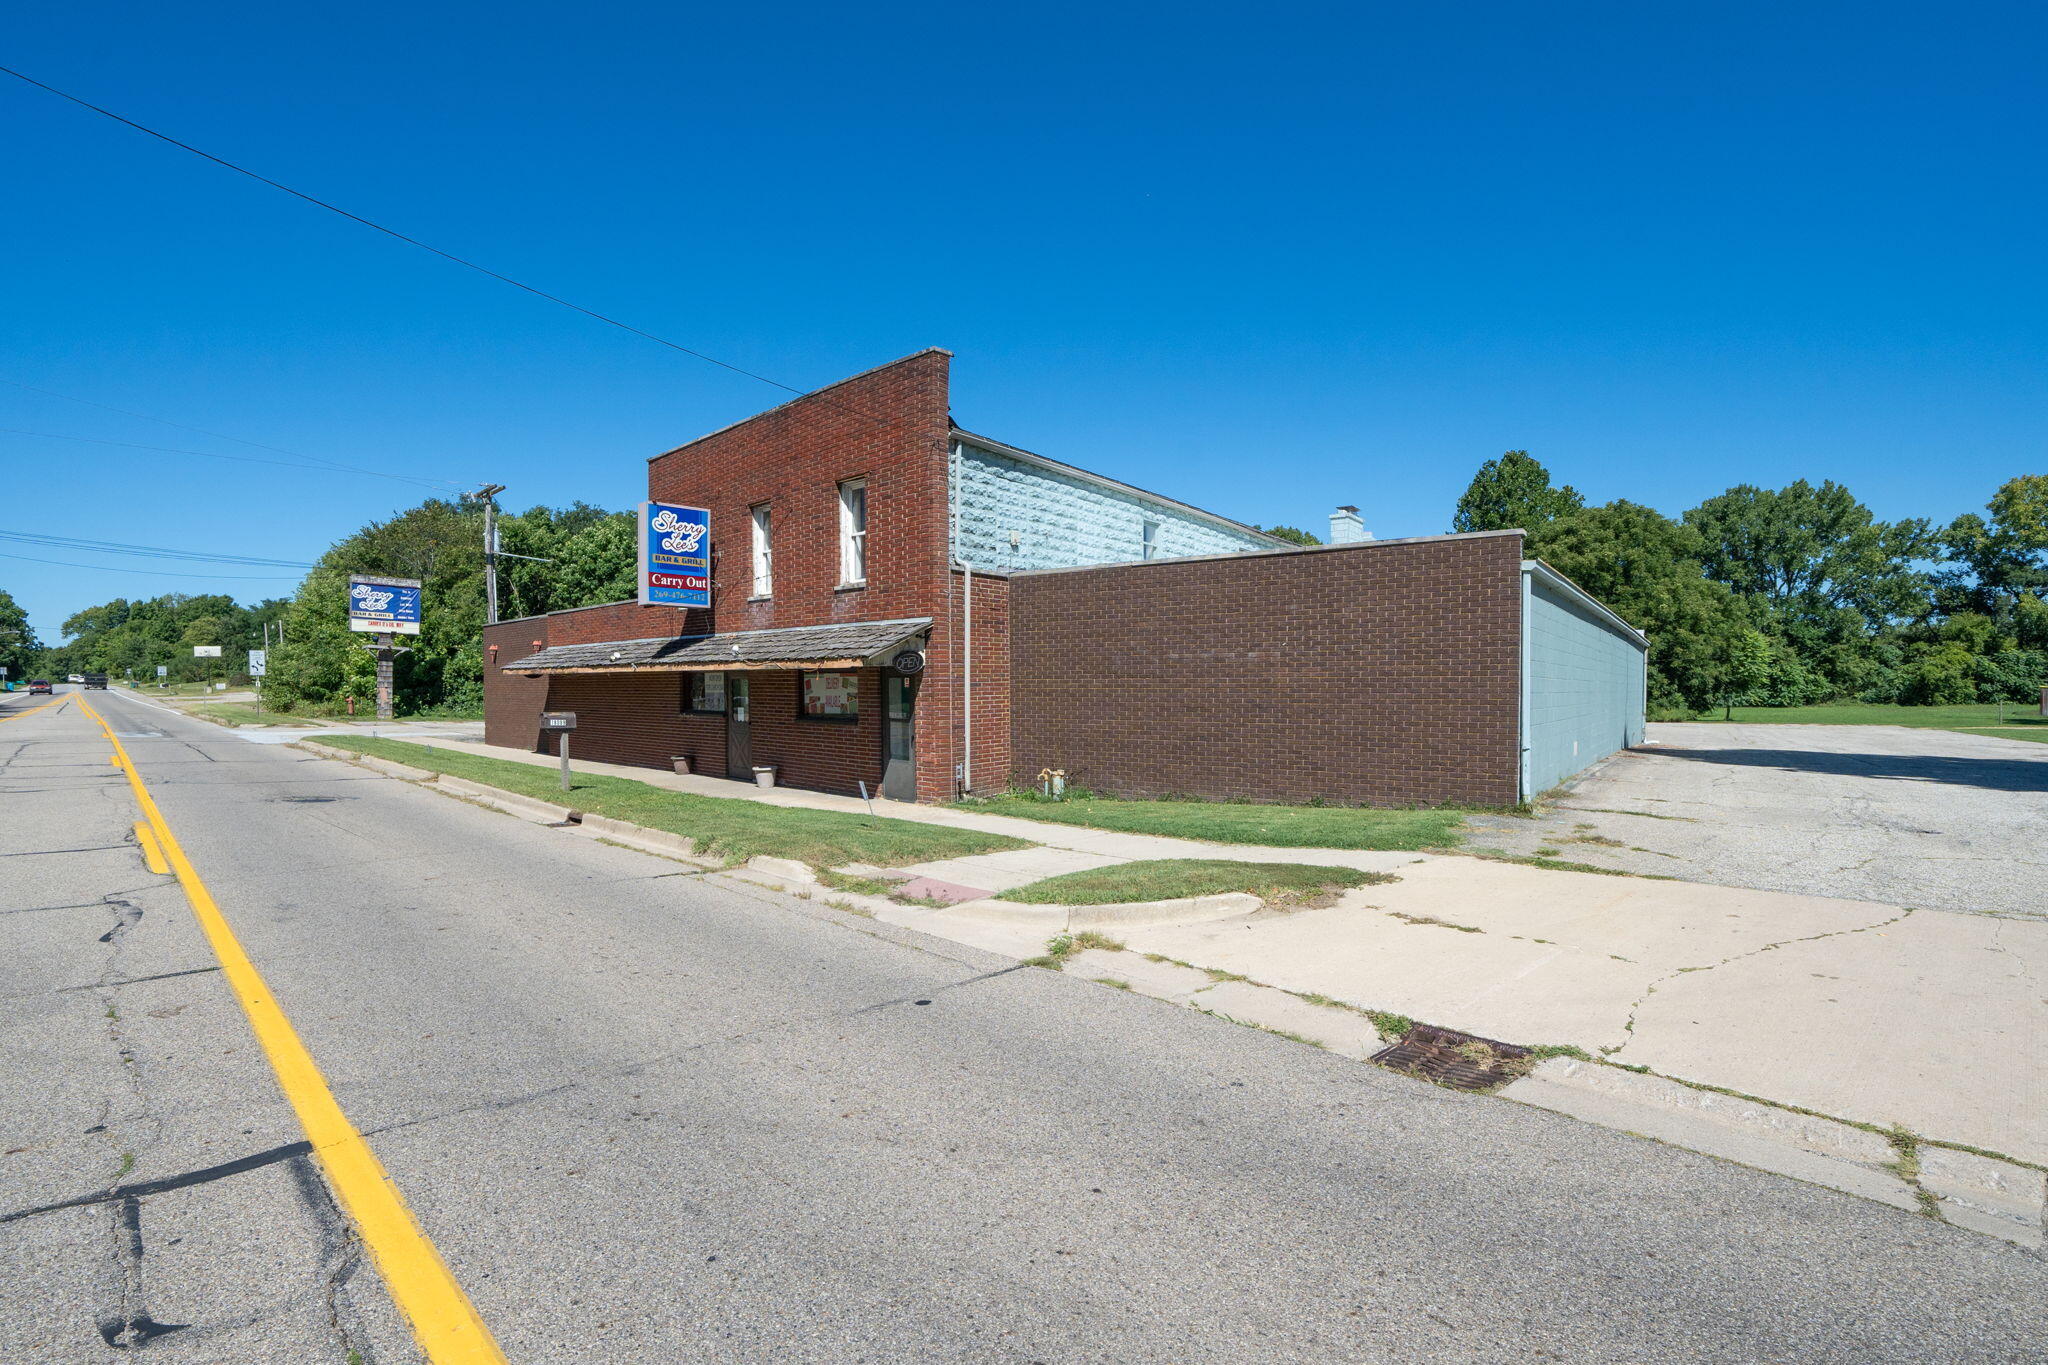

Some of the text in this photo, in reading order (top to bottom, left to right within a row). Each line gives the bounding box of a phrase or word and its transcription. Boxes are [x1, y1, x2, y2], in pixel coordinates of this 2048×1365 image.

[652, 511, 706, 538] Sherry
[662, 532, 698, 552] Lee's
[652, 573, 706, 588] Carry Out
[352, 585, 393, 602] Sherry
[359, 597, 387, 610] Lee's
[896, 657, 920, 669] OPEN
